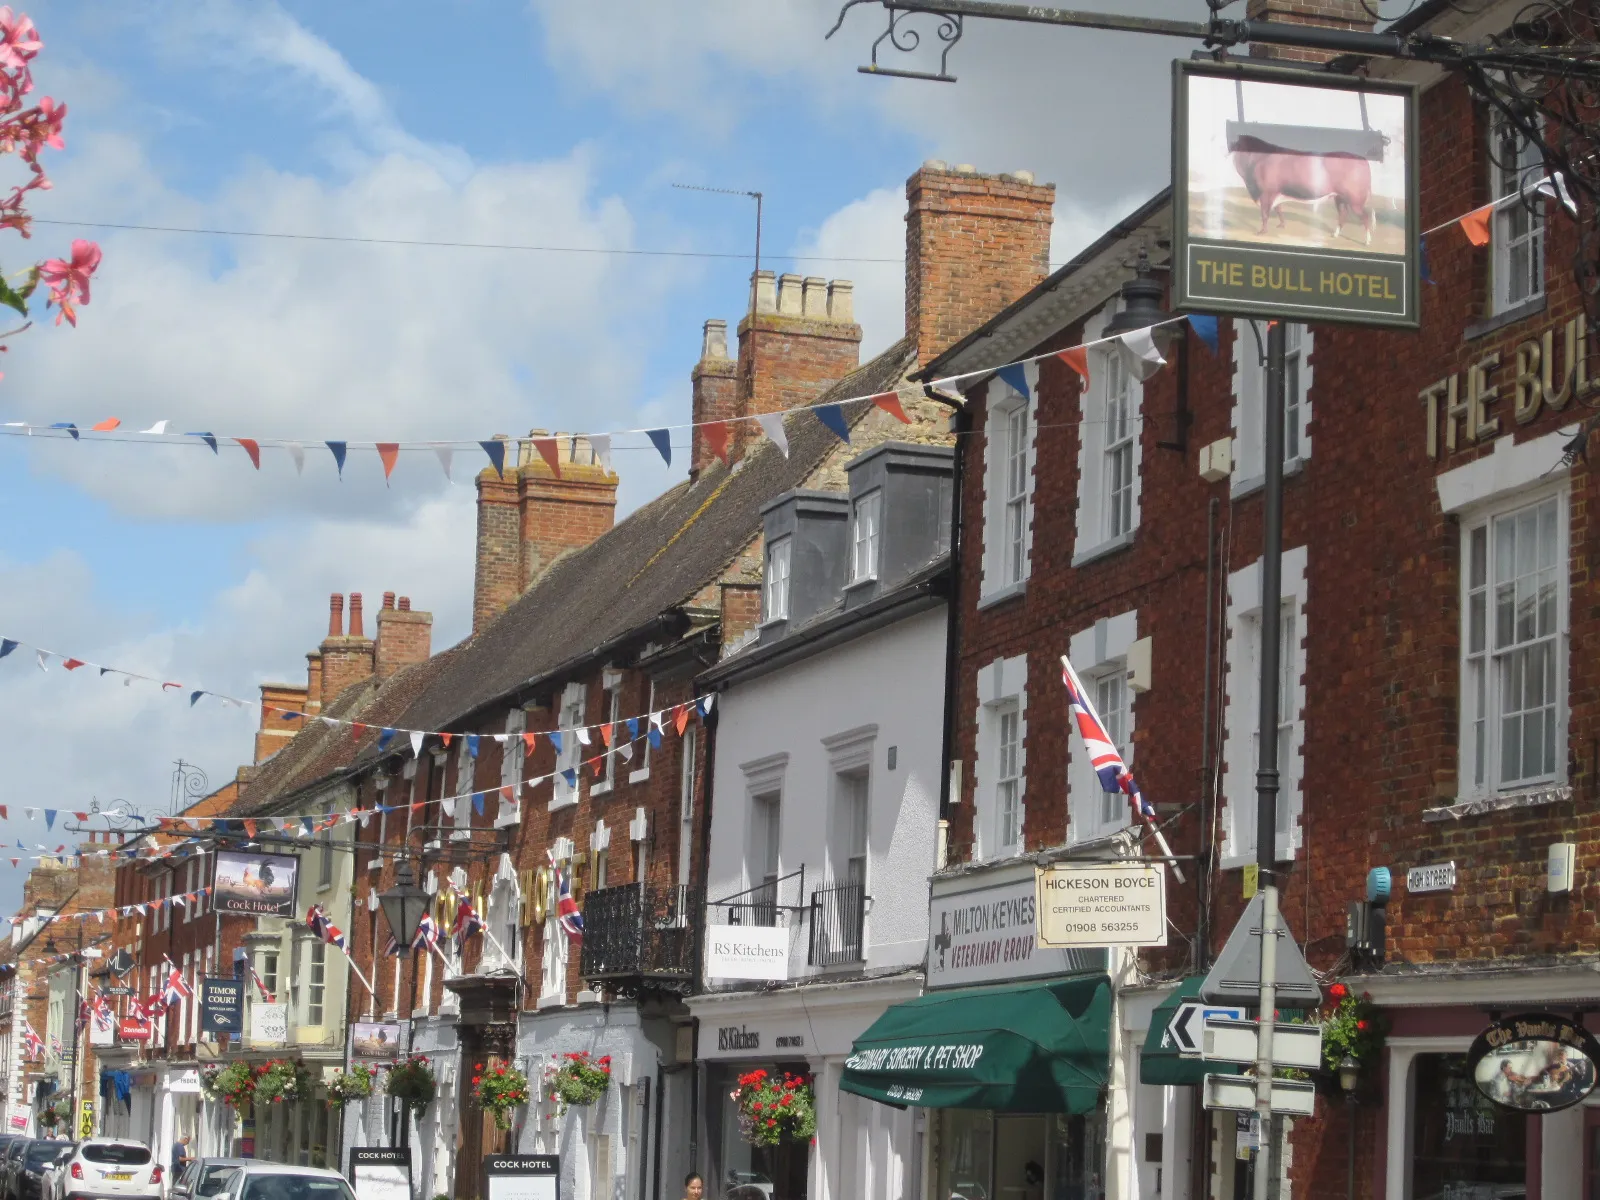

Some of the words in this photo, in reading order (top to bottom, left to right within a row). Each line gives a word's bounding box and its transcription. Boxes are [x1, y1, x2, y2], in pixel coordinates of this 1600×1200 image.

[1197, 260, 1243, 286] THE
[1252, 265, 1312, 292] BULL
[1320, 271, 1397, 299] HOTEL
[1418, 352, 1500, 460] THE
[1046, 878, 1110, 889] HICKESON
[1114, 877, 1155, 888] BOYCE
[1408, 872, 1425, 888] HIGH
[1425, 868, 1452, 887] STREET
[227, 900, 251, 911] Cock
[253, 901, 280, 913] Hotel
[953, 904, 990, 936] MILTON
[992, 896, 1035, 929] KEYNES
[1065, 924, 1097, 932] 01908
[1101, 923, 1139, 931] 563255
[714, 943, 730, 955] RS
[733, 943, 784, 957] Kitchens
[951, 939, 1002, 969] VETERINARY
[1003, 935, 1034, 963] GROUP
[208, 986, 237, 995] TIMOR
[208, 996, 237, 1004] COURT
[718, 1027, 729, 1050] RS
[729, 1024, 759, 1049] Kitchens
[886, 1046, 928, 1070] SURGERY
[924, 1045, 935, 1070] &
[934, 1045, 955, 1069] PET
[952, 1044, 983, 1068] SHOP
[493, 1160, 519, 1169] COCK
[521, 1160, 551, 1169] HOTEL
